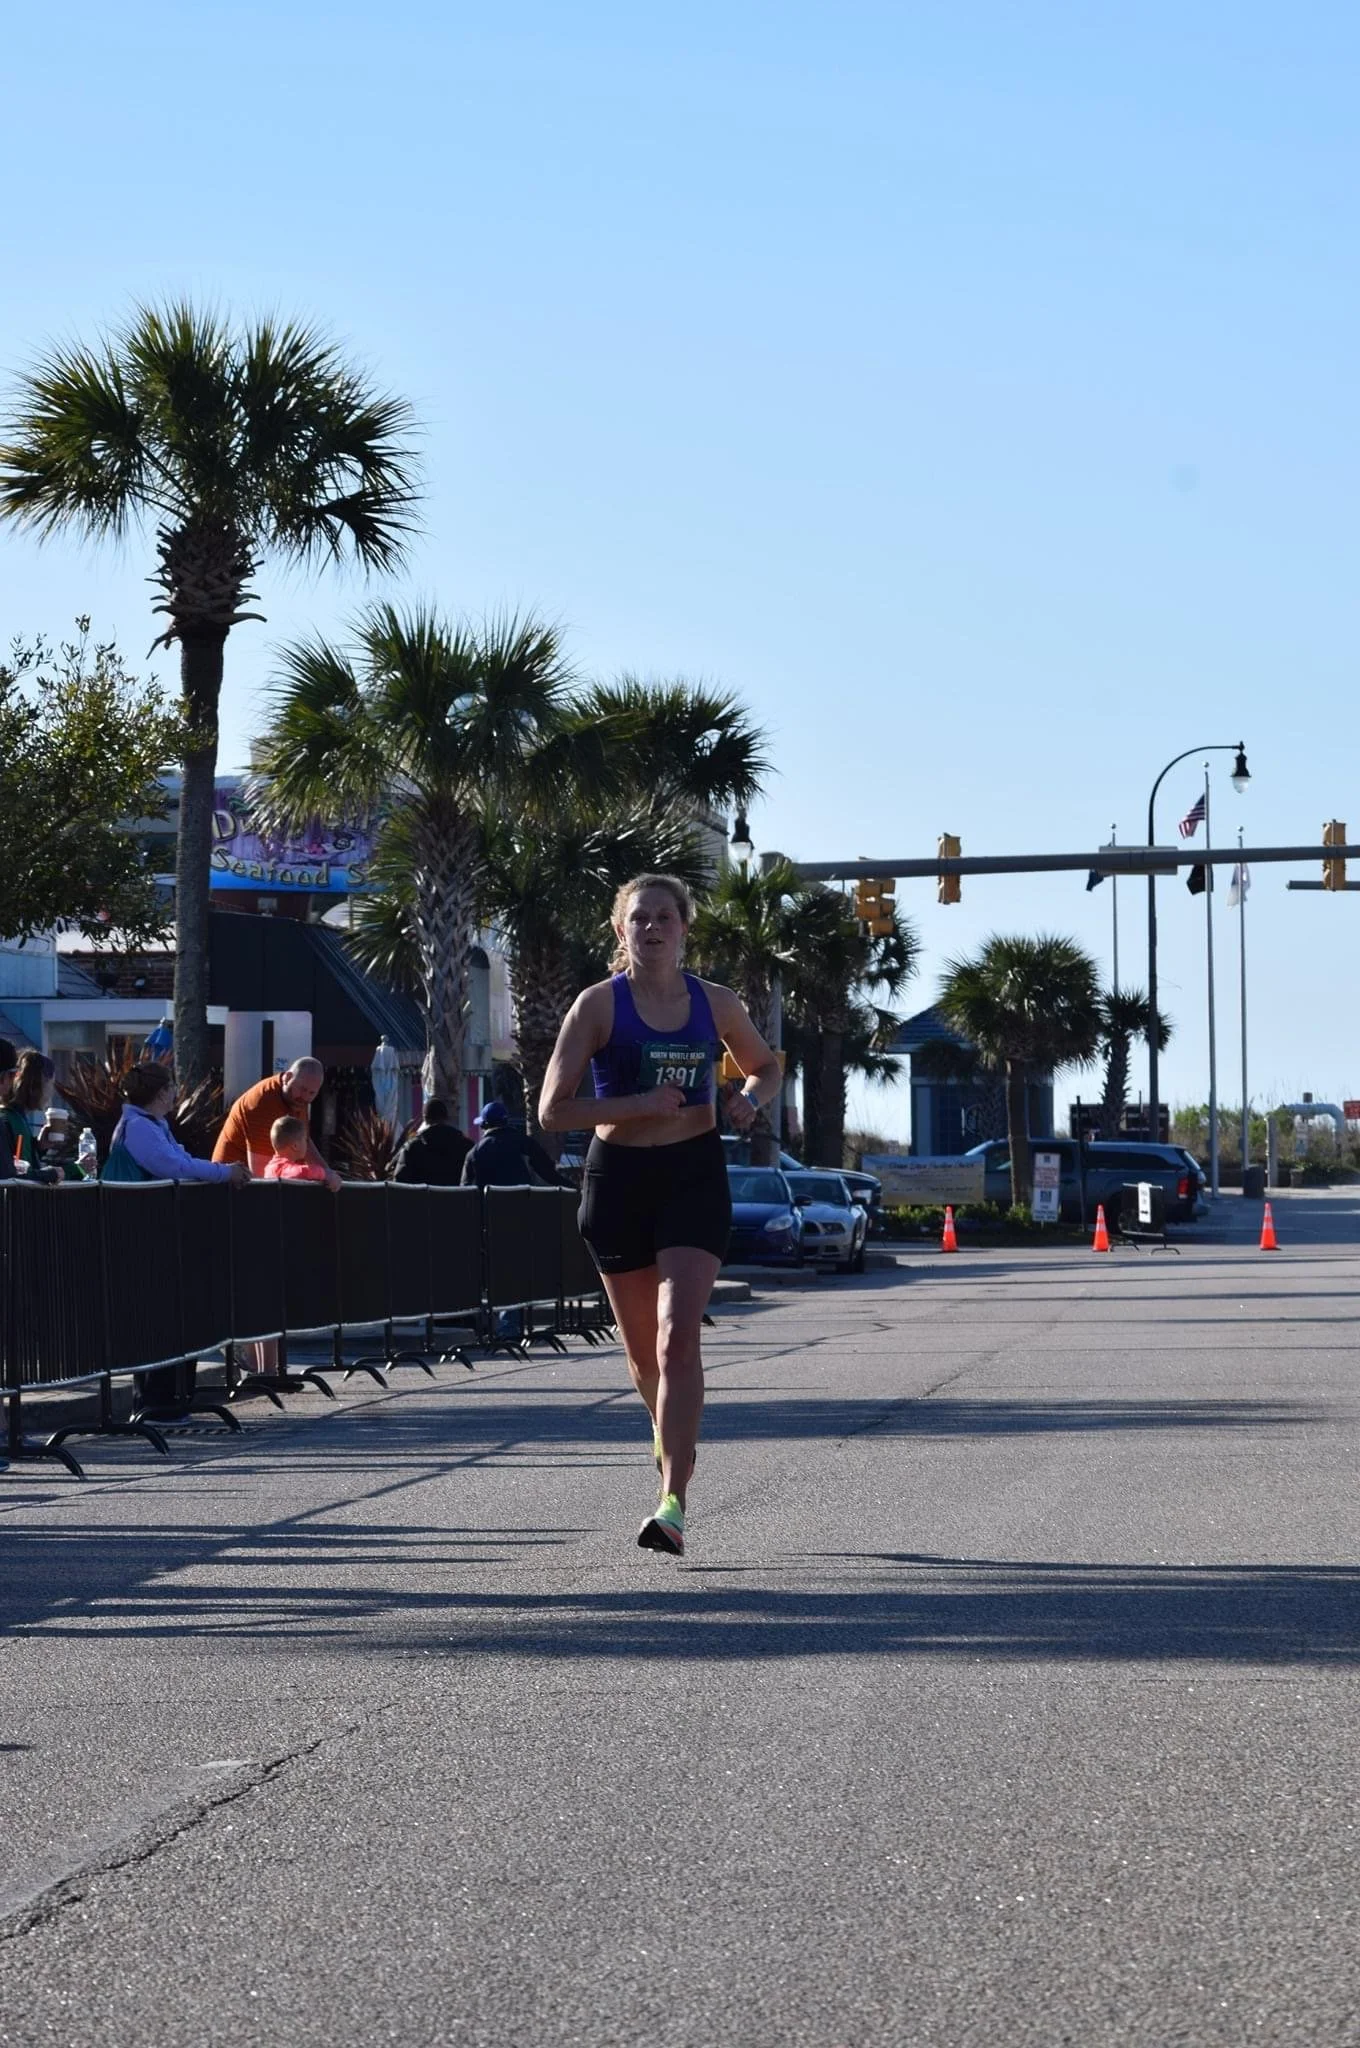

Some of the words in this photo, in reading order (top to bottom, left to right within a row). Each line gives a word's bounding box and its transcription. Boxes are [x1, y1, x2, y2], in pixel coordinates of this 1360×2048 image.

[209, 845, 331, 887] Seafood
[650, 1051, 667, 1059] NORTH
[669, 1051, 689, 1060] MYRTLE
[690, 1052, 705, 1060] BEACH
[655, 1066, 697, 1087] 1391
